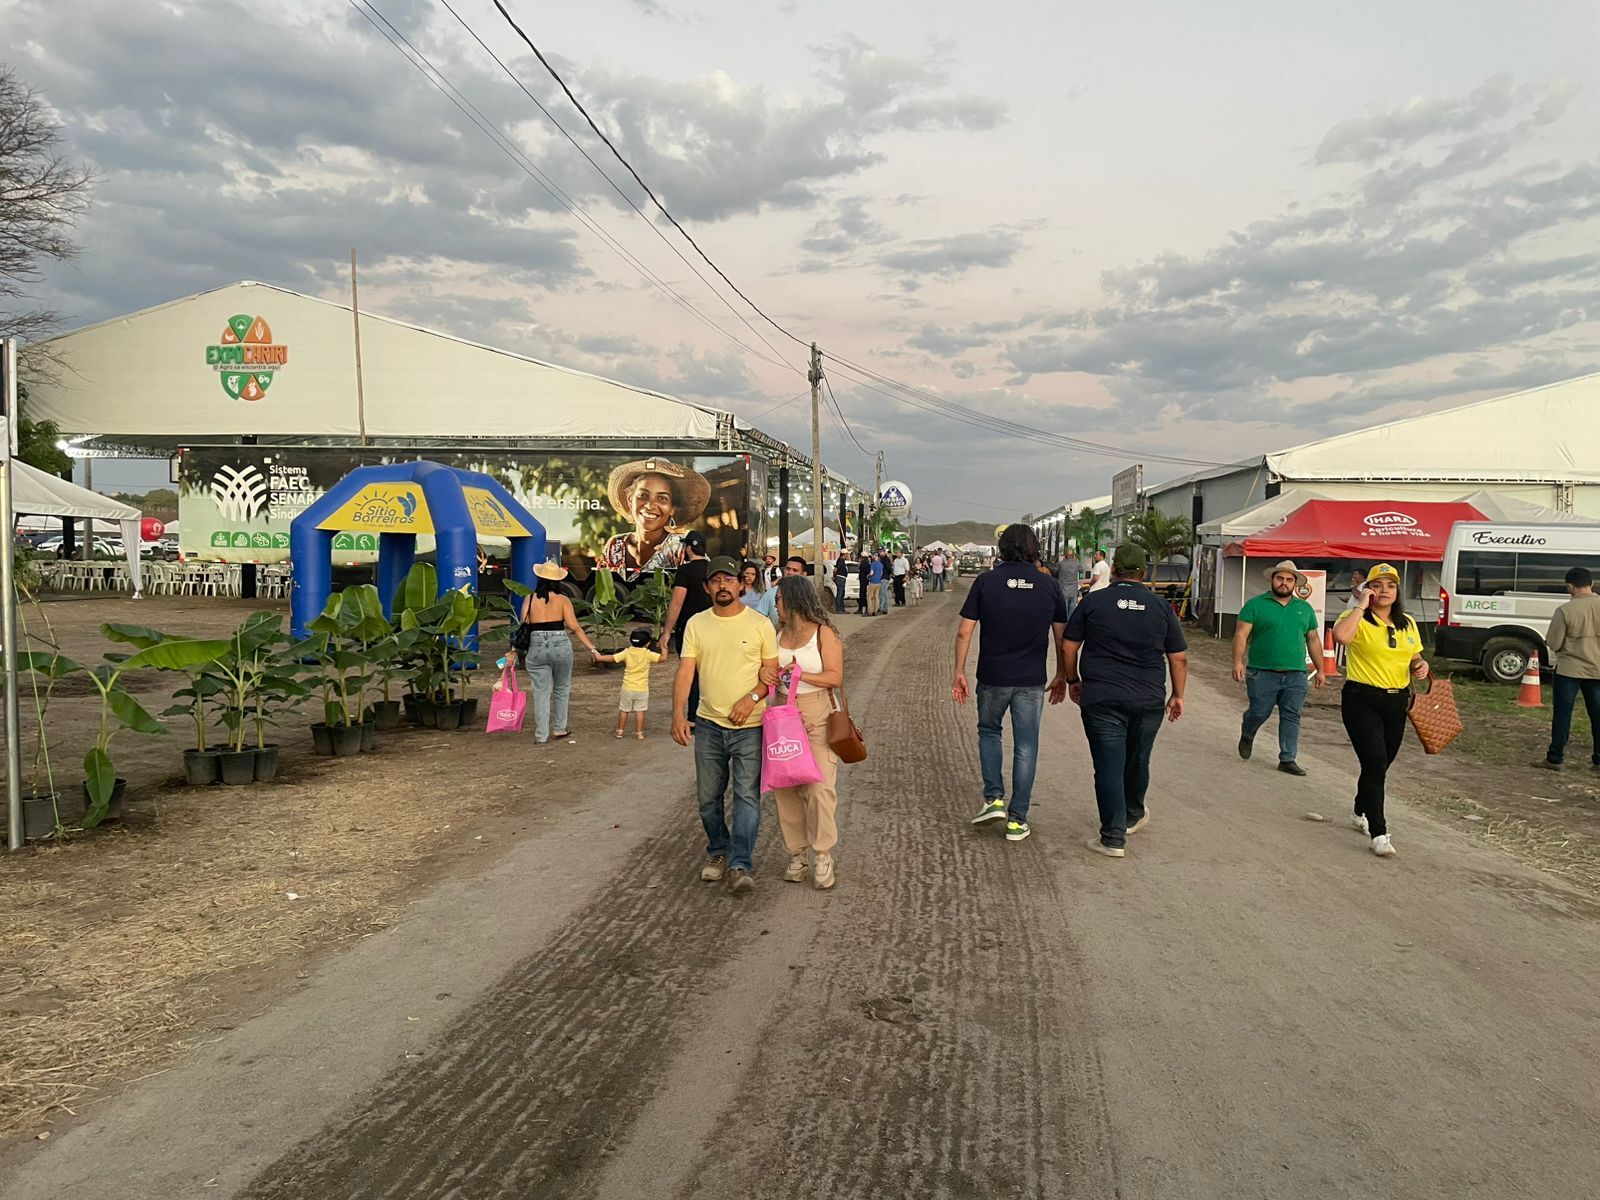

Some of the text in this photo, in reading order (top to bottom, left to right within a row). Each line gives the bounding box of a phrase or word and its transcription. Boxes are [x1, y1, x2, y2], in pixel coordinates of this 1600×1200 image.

[269, 465, 307, 475] Sistema
[270, 475, 310, 490] FAEC
[270, 492, 315, 505] SENAR
[519, 494, 605, 511] AR ensina.
[269, 508, 298, 520] Sindi
[352, 511, 416, 524] Barreiras
[1369, 515, 1412, 525] IHARA
[1368, 526, 1424, 534] Agricultura
[1472, 531, 1547, 545] Executivo
[1465, 600, 1498, 611] ARCE
[769, 743, 799, 755] TIJUCA
